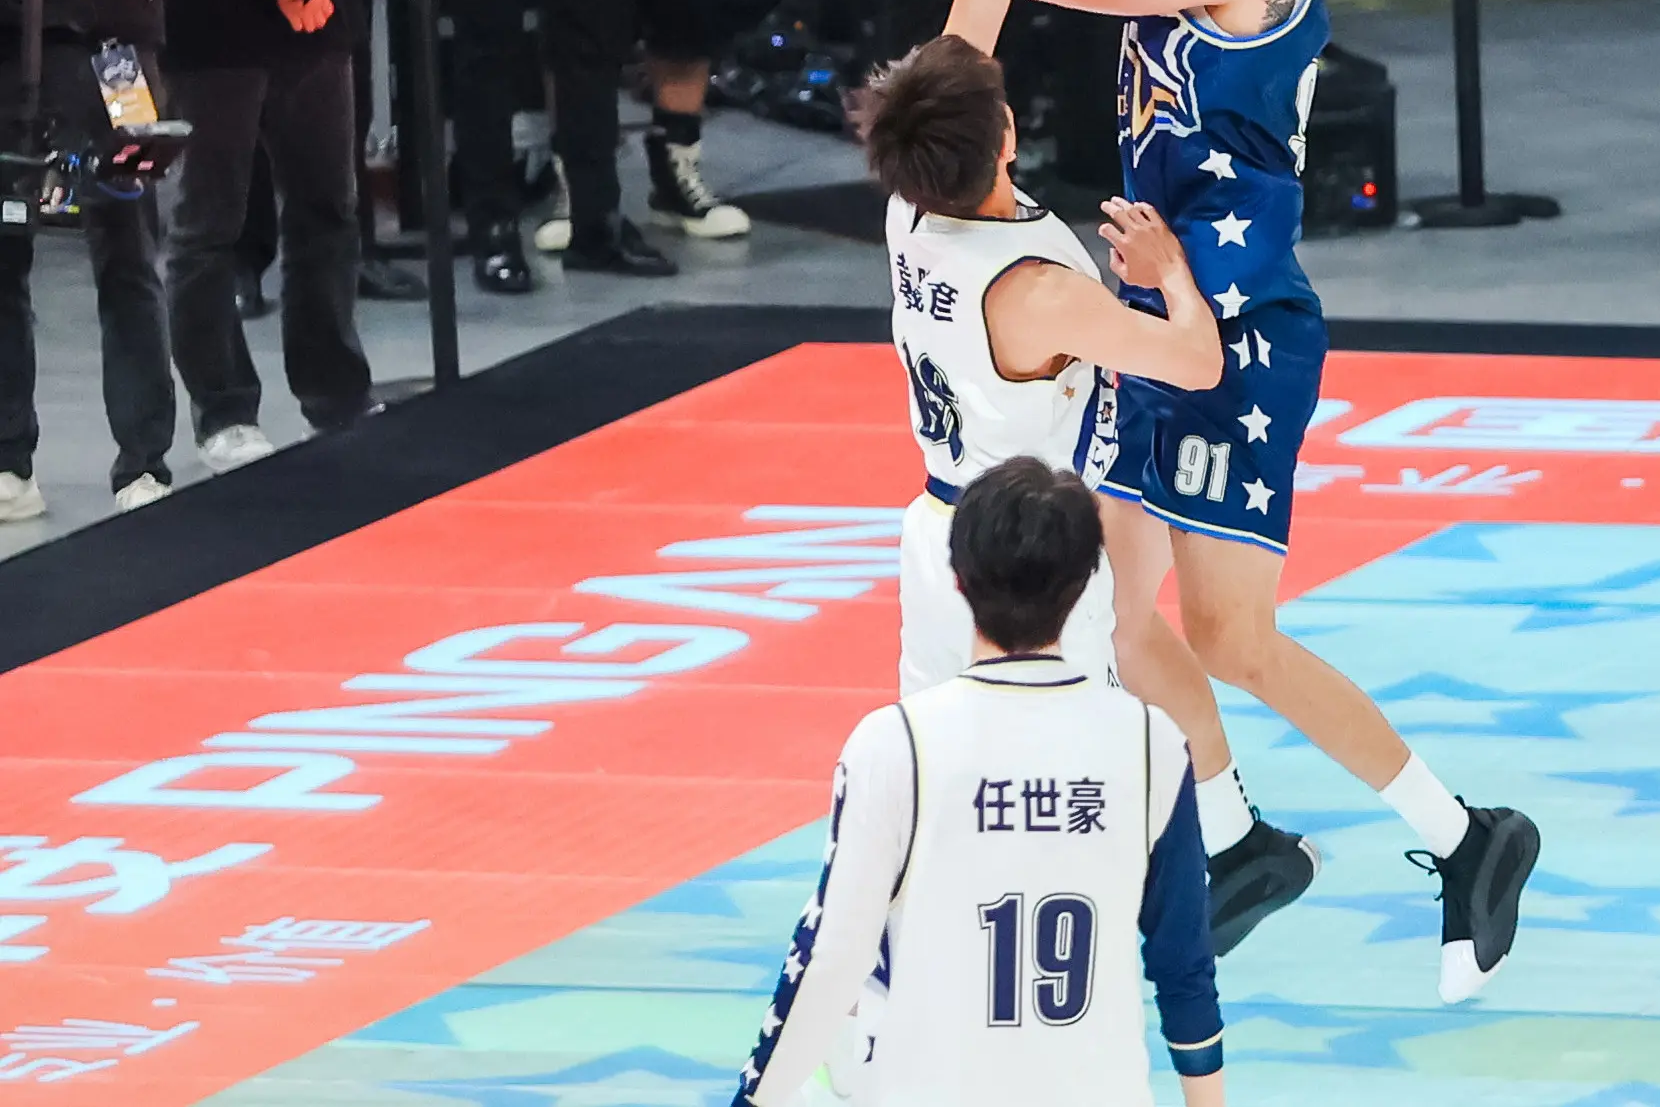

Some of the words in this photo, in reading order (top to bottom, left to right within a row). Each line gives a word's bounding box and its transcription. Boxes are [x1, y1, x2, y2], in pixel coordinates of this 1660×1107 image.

[1174, 434, 1231, 503] 91
[972, 776, 1107, 835] 任世豪
[977, 892, 1098, 1027] 19
